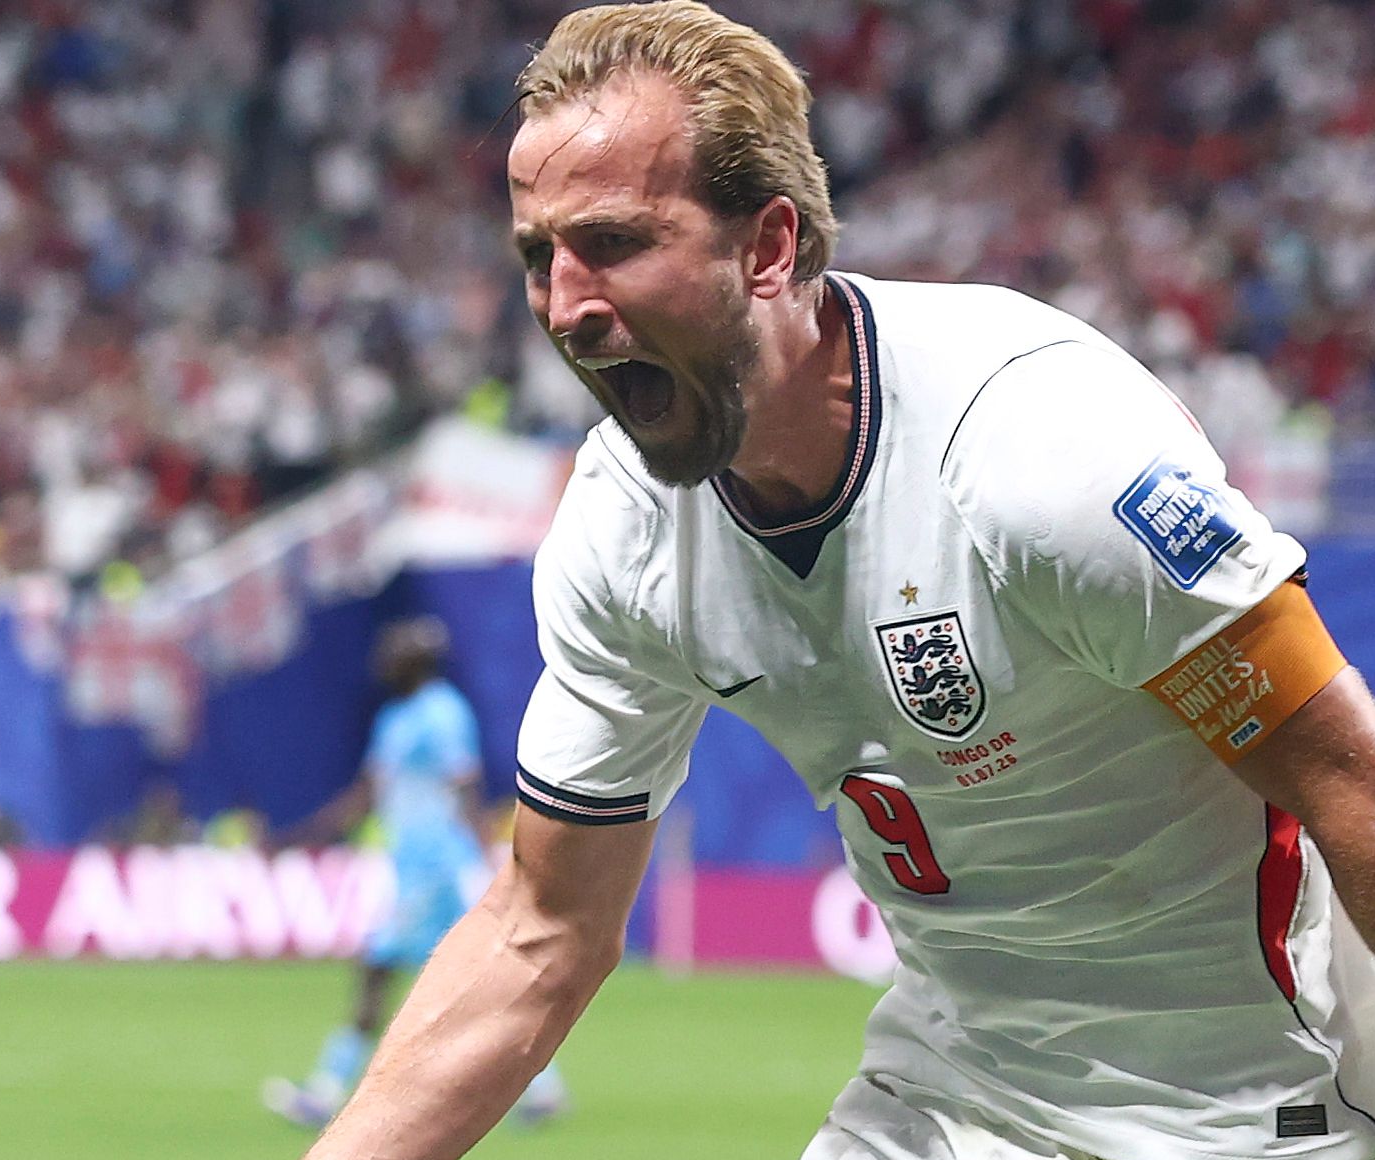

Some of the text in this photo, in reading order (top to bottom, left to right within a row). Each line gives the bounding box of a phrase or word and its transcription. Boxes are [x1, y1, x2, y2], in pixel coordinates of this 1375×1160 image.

[1148, 486, 1203, 538] UNITES
[1160, 637, 1238, 700] FOOTBALL
[1175, 651, 1254, 721] UNITES
[1217, 669, 1275, 728] World
[989, 731, 1017, 752] DR
[1229, 720, 1261, 748] FIFA
[956, 754, 1017, 787] 01.07.26
[839, 774, 952, 895] 9
[43, 842, 399, 961] AIRW
